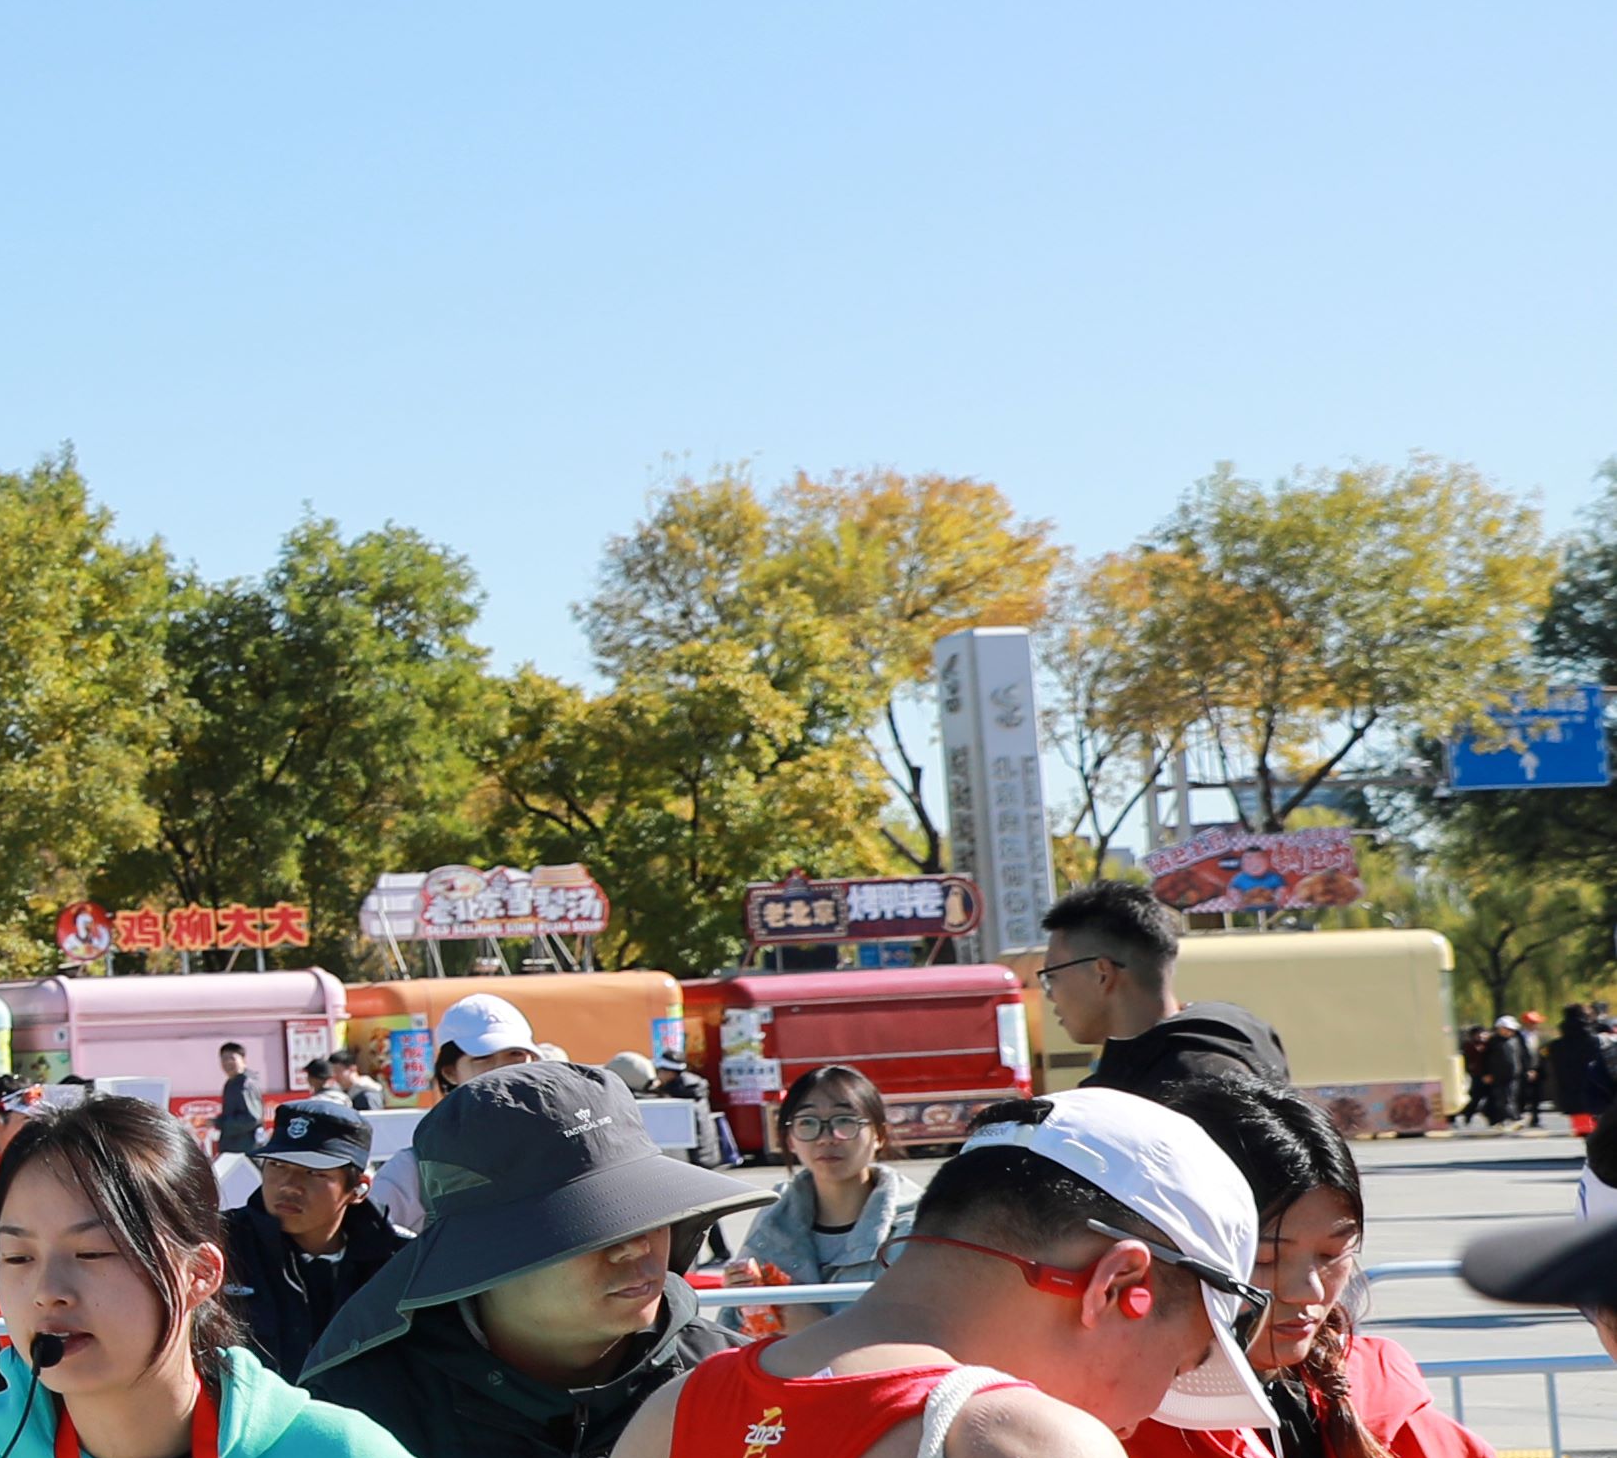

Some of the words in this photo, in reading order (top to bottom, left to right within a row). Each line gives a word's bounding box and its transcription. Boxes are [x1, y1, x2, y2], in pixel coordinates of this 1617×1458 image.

[115, 902, 310, 951] 鸡柳大大
[744, 1424, 786, 1445] 2025
